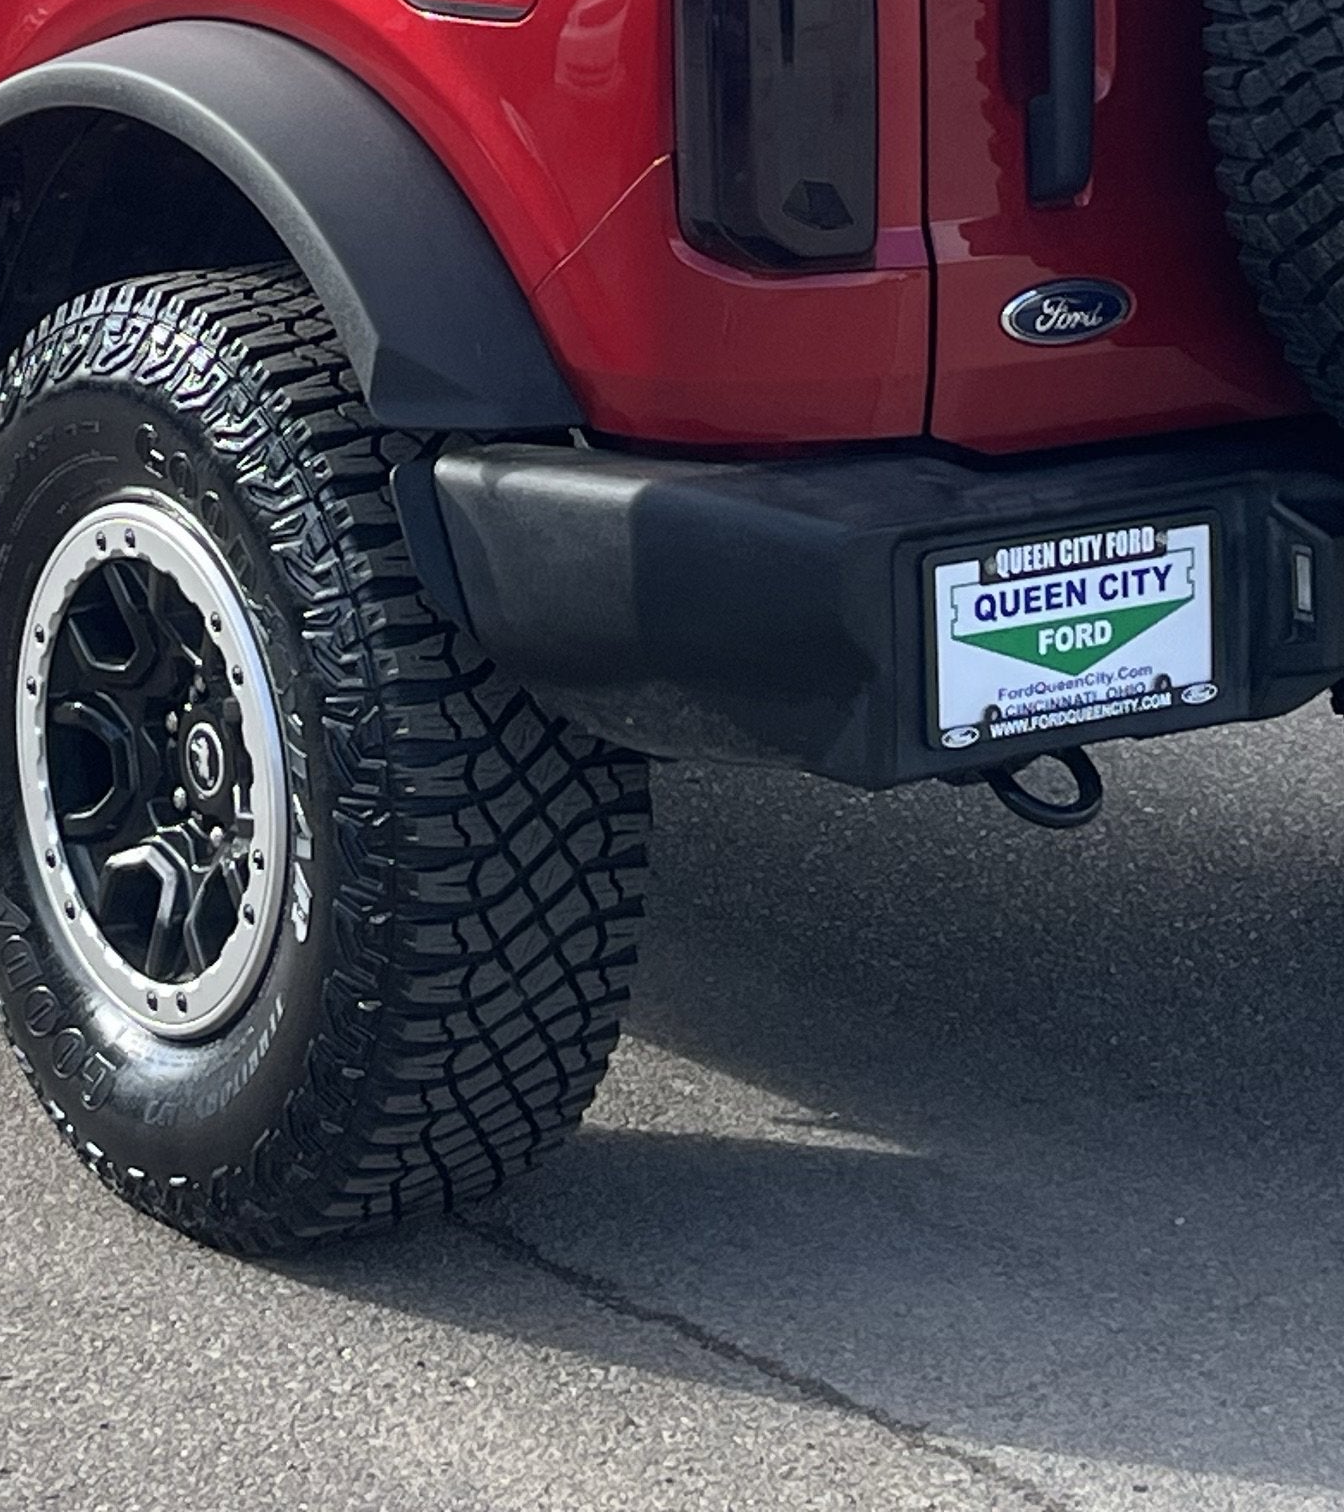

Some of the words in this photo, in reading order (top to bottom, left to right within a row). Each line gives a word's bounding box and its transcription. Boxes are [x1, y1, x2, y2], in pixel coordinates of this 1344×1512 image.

[1034, 295, 1103, 333] Ford
[996, 541, 1056, 579] QUEEN
[1058, 533, 1104, 566] CITY
[1106, 526, 1155, 559] FORD
[974, 577, 1087, 622] QUEEN
[1098, 563, 1174, 601] CITY
[1038, 619, 1113, 656] FORD
[997, 664, 1153, 701] FordQueenCity.Com
[989, 691, 1172, 739] WWW.FORDQUEENCITY.COM
